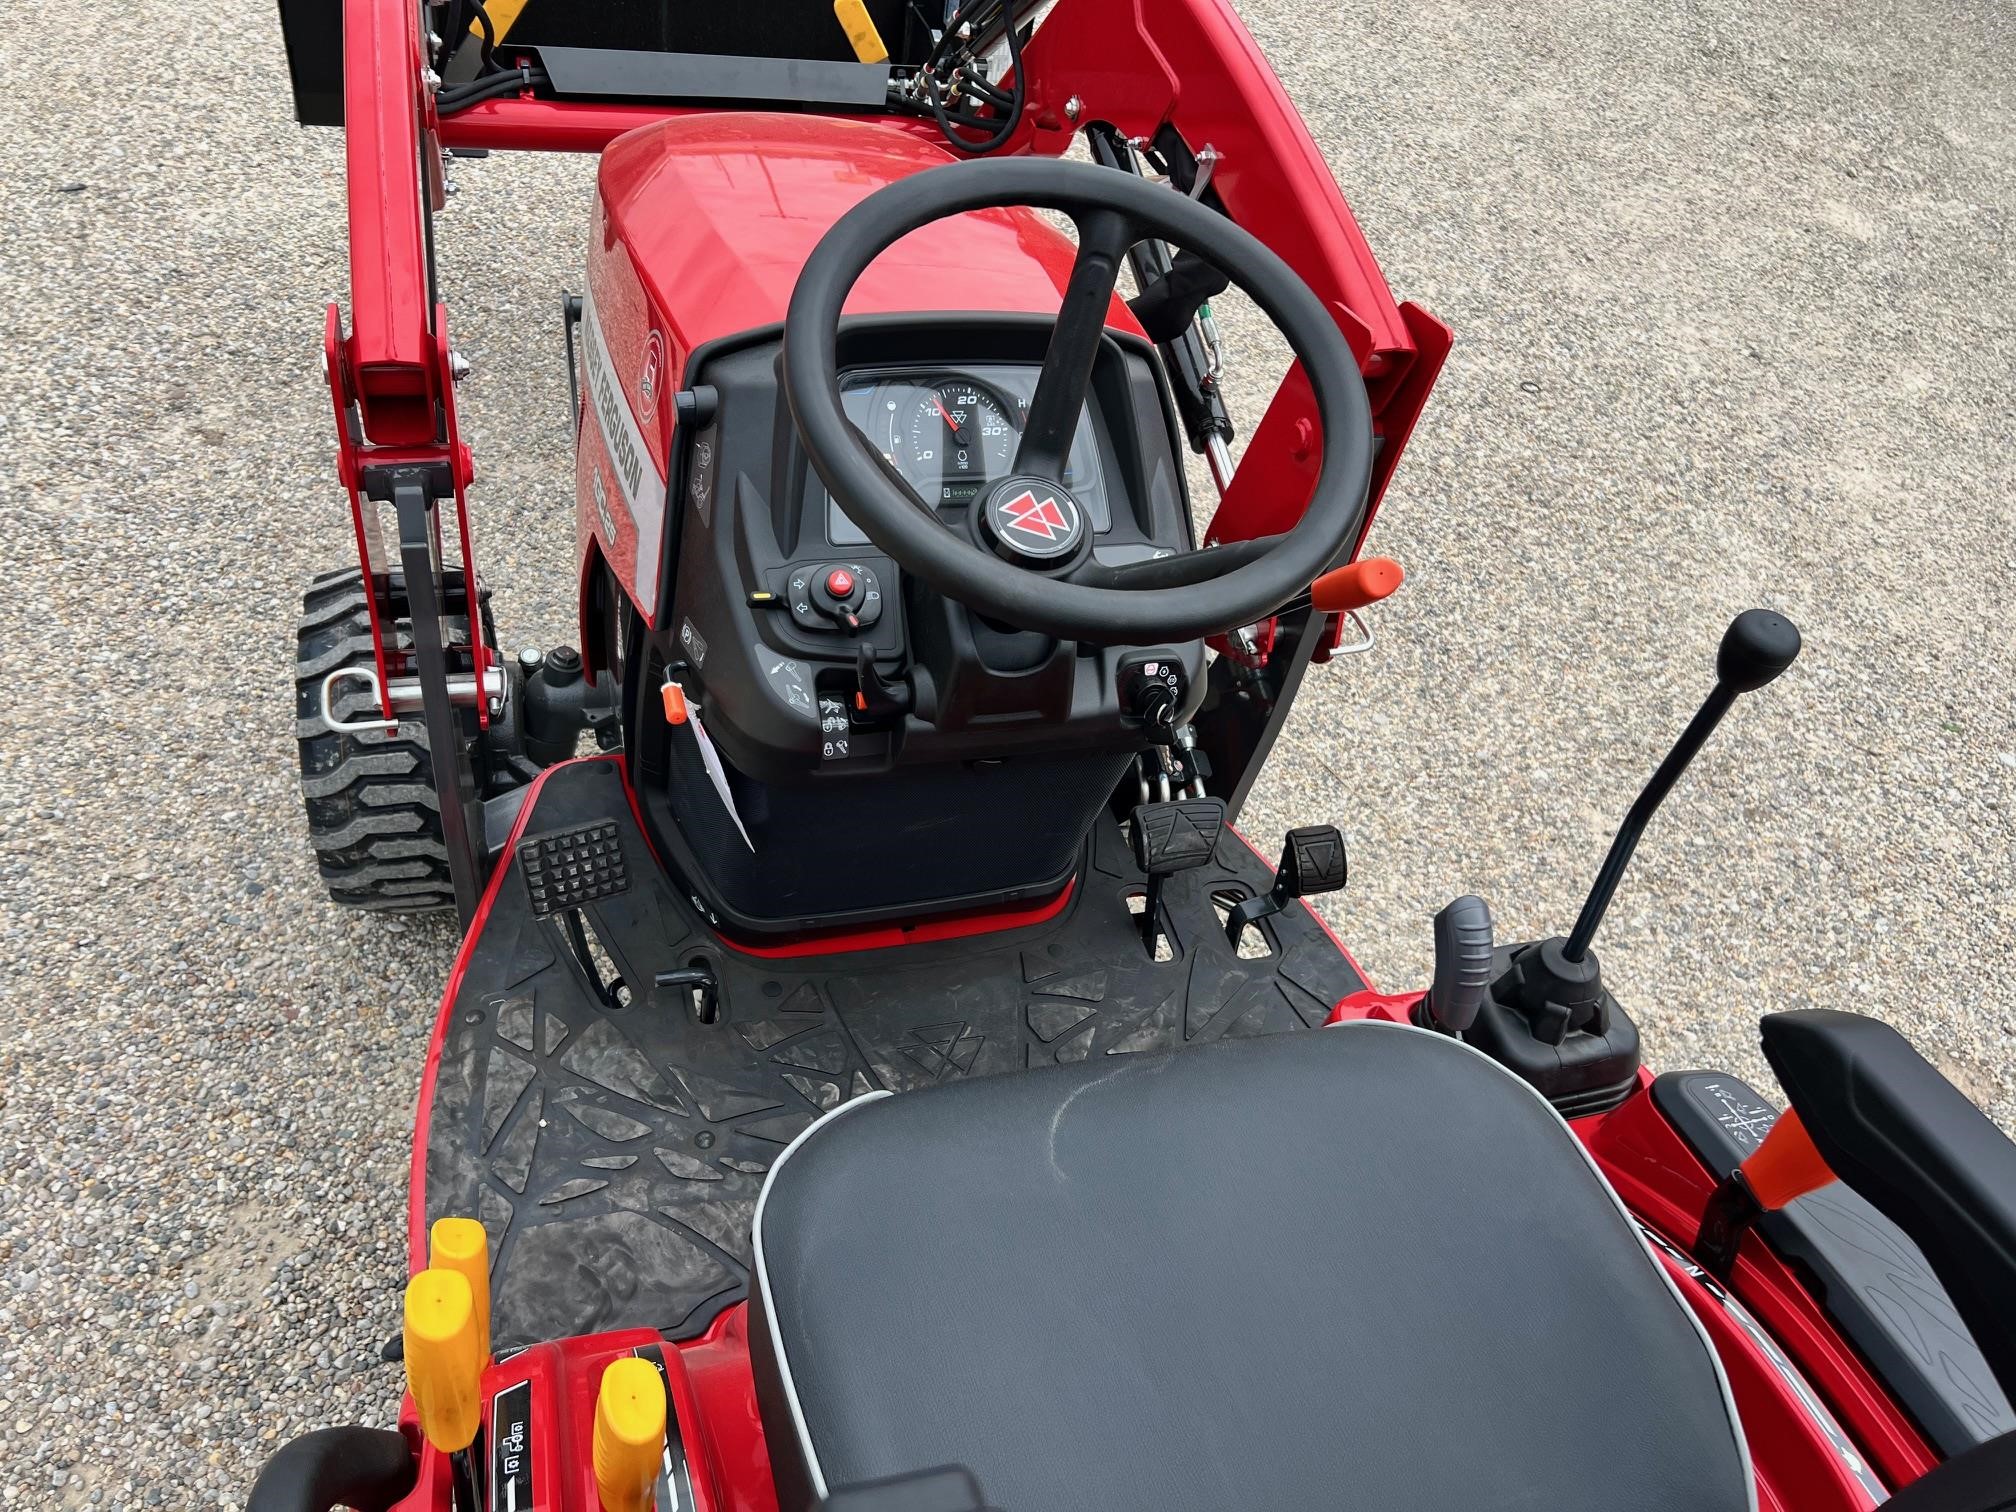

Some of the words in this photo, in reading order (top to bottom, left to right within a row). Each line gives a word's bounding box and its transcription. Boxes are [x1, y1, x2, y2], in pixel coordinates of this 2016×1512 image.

[957, 395, 977, 405] 20
[1017, 398, 1026, 408] H
[925, 407, 941, 417] 10
[598, 371, 642, 500] FERGUSON
[981, 426, 1002, 436] 30
[923, 450, 933, 459] 0
[1684, 1265, 1705, 1277] N
